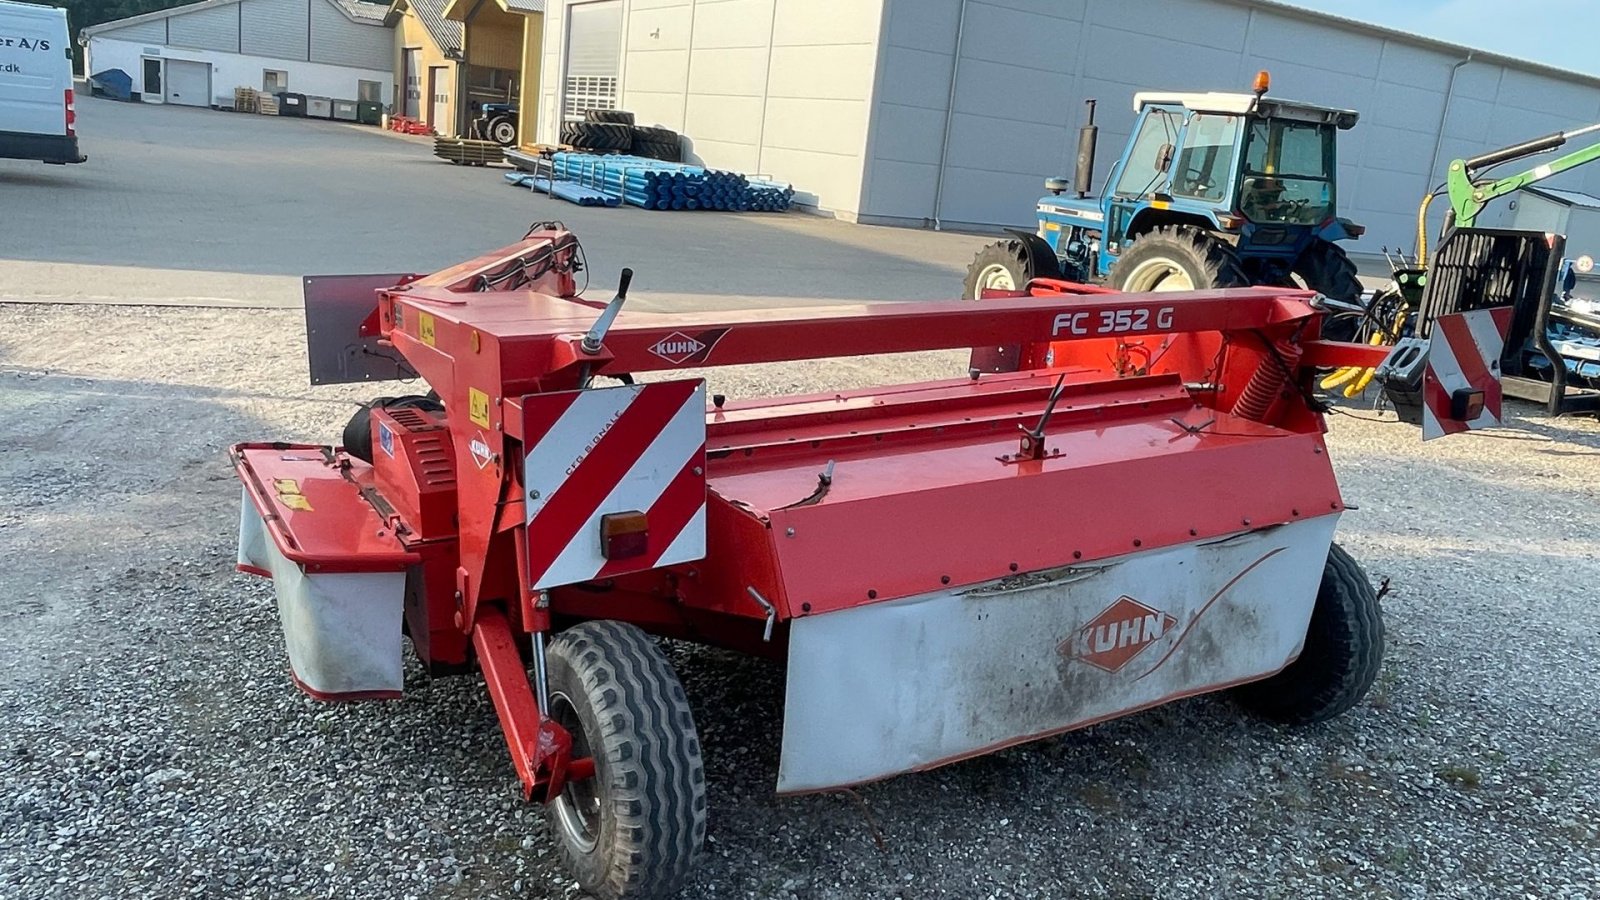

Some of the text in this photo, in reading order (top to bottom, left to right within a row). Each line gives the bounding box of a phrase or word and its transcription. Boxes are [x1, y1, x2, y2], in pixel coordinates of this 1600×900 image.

[18, 38, 50, 51] A/S
[1052, 307, 1174, 336] FC 352 G
[656, 340, 697, 355] KUHN
[1070, 611, 1165, 659] KUHN
